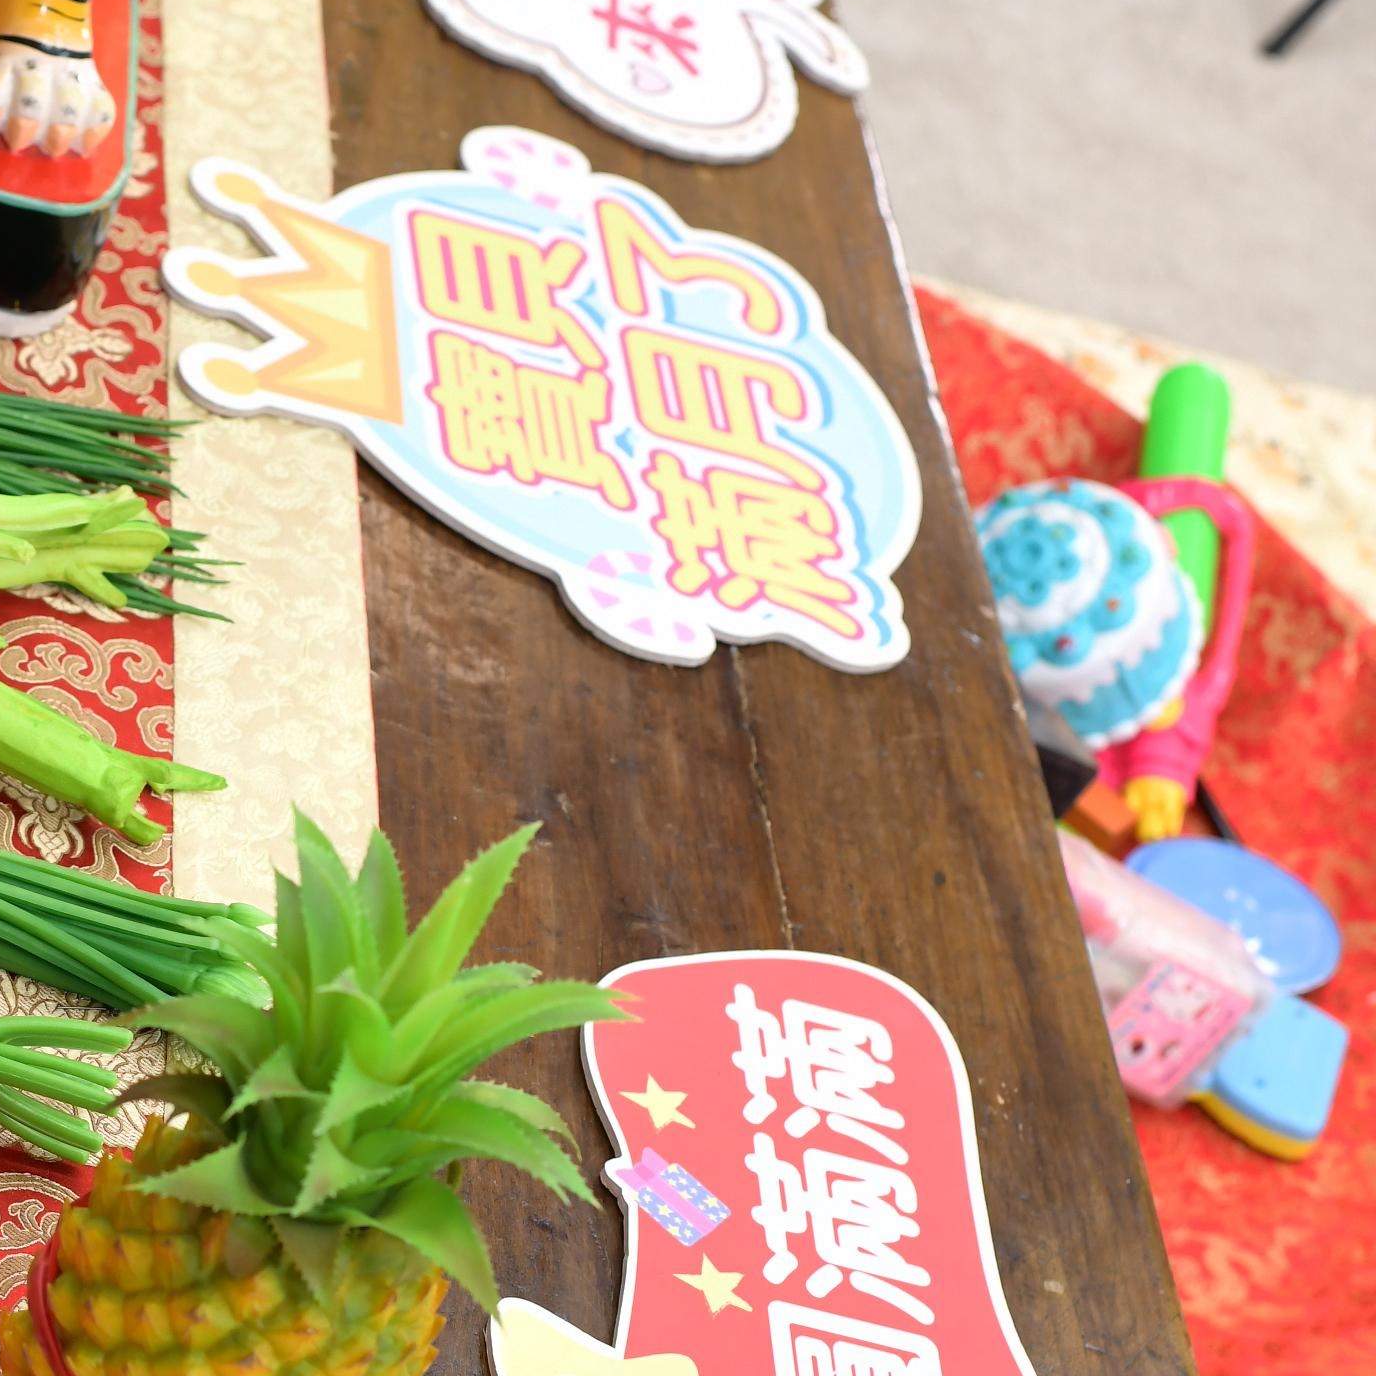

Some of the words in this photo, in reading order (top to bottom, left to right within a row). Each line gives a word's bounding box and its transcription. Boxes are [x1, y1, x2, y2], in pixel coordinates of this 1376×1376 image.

[407, 208, 639, 512] 寶貝
[595, 195, 865, 641] 滿月了
